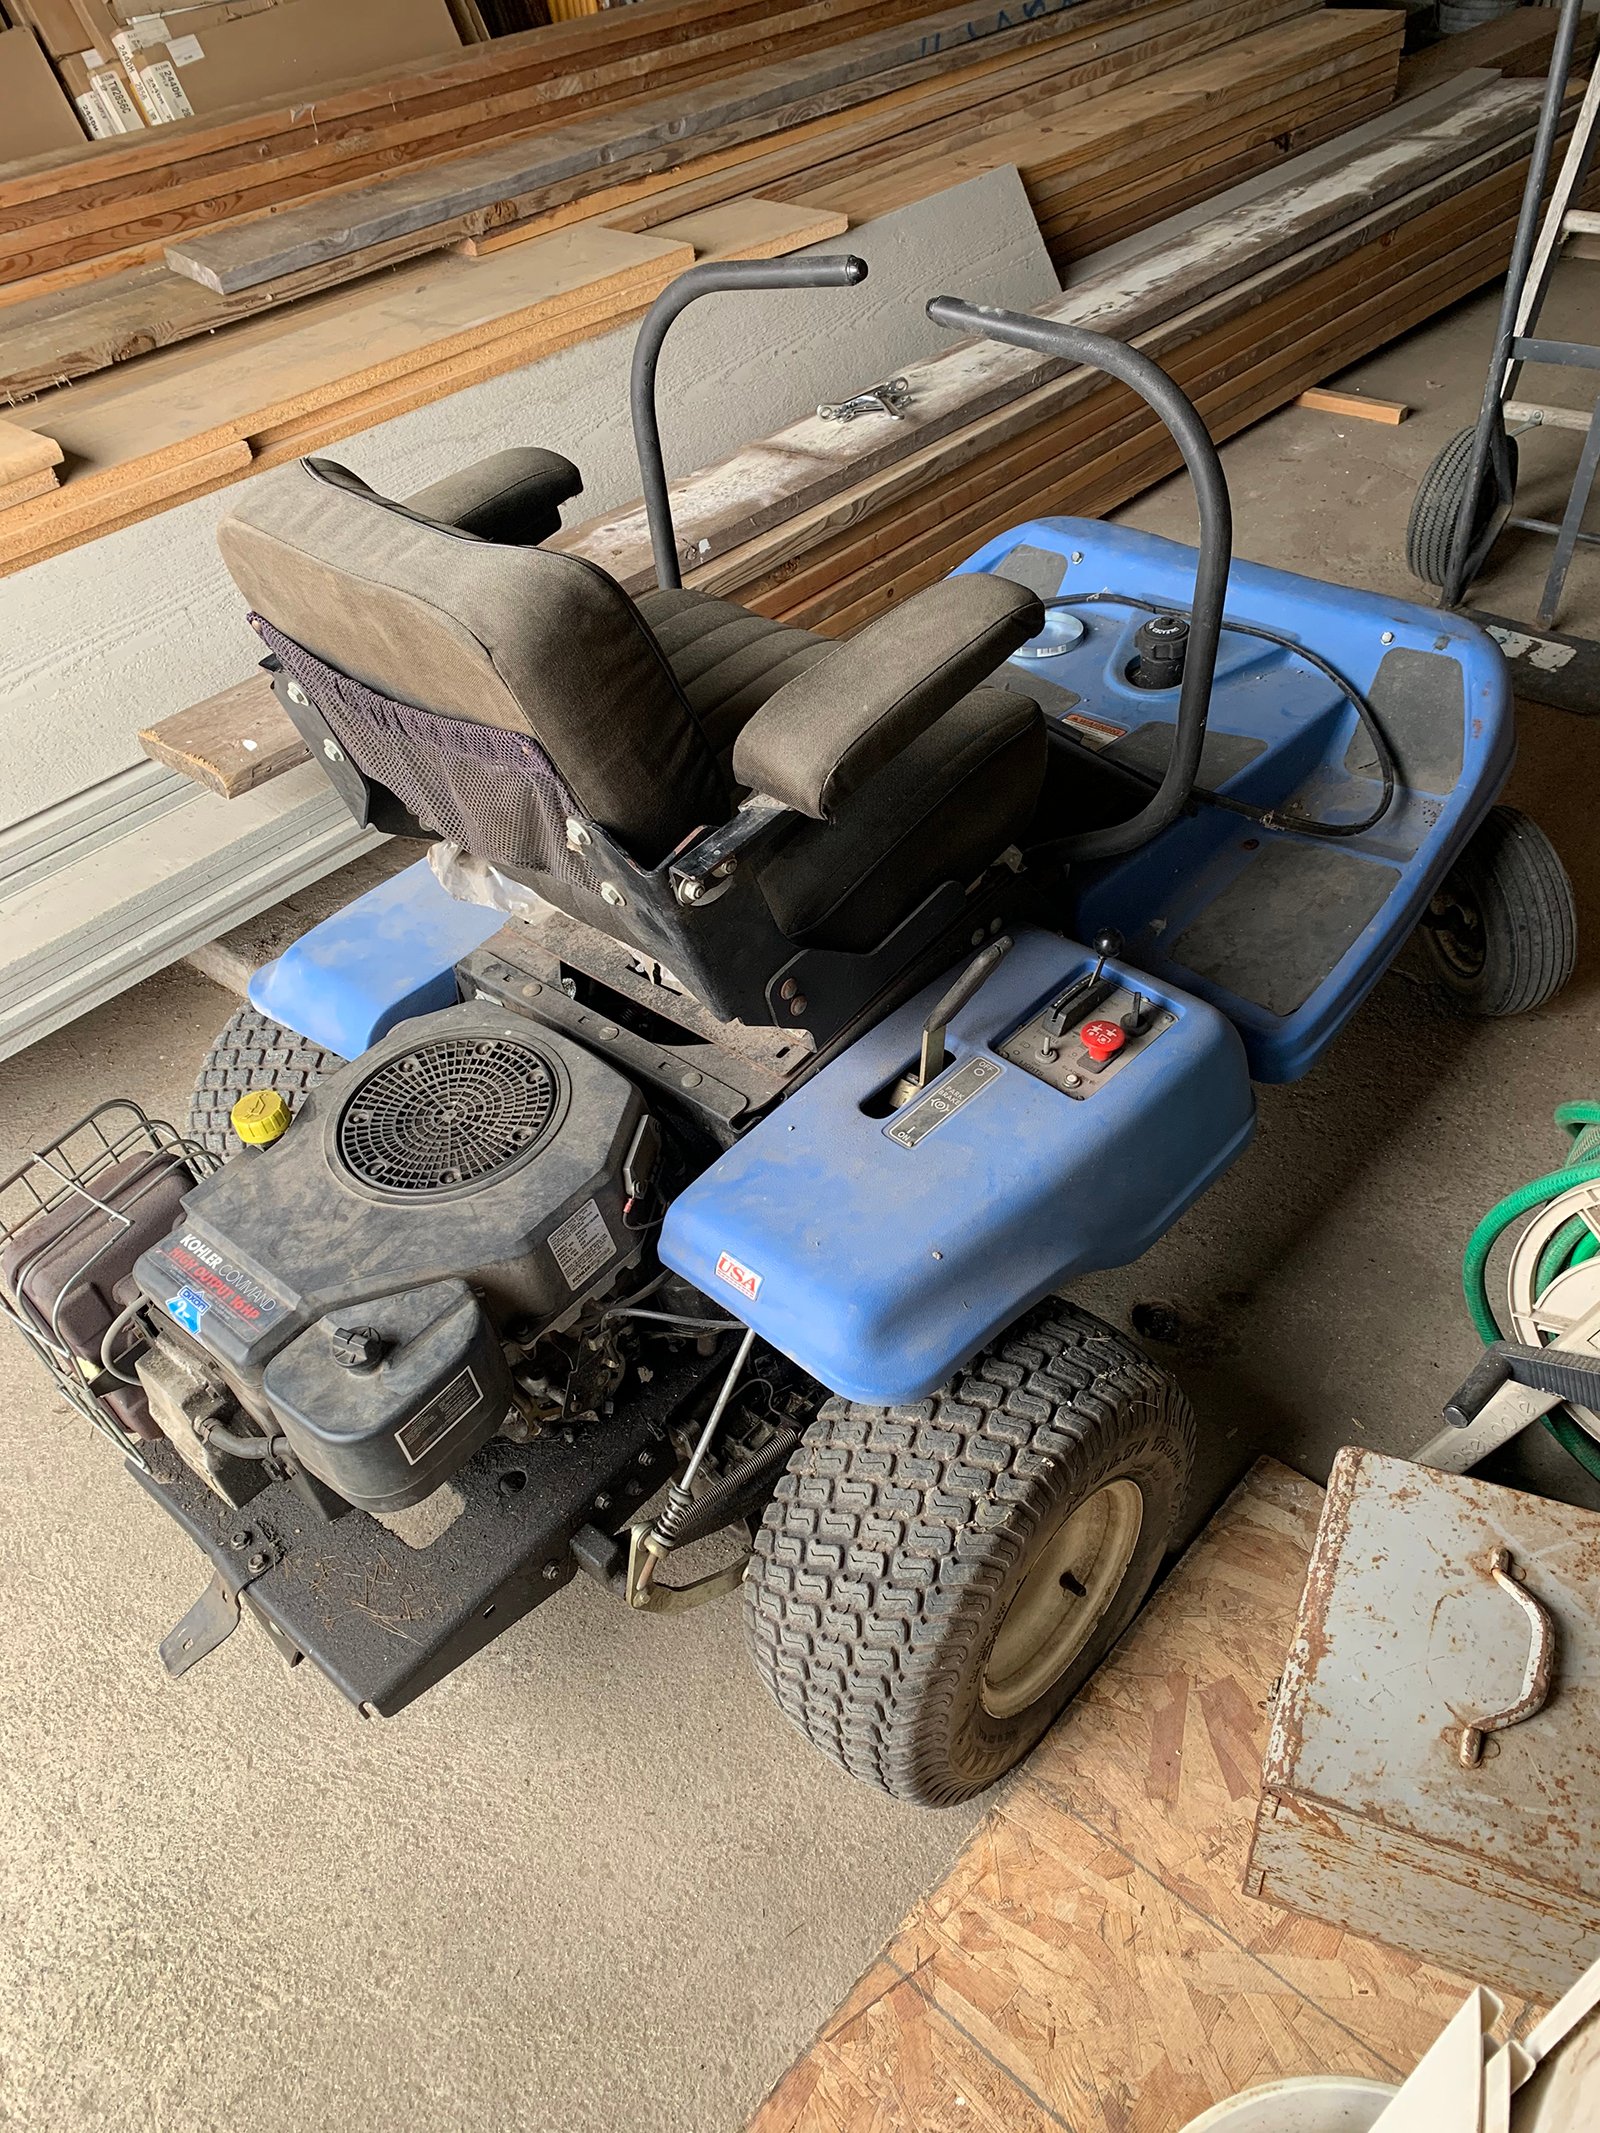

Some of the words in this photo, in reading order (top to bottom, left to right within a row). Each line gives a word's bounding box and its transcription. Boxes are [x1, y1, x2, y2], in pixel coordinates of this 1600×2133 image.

[978, 1061, 995, 1072] OFF
[1018, 1060, 1045, 1077] LIGHTS
[938, 1089, 962, 1105] BRAKE
[944, 1085, 966, 1100] PARK
[897, 1131, 911, 1142] ON
[168, 1247, 199, 1275] HIGH
[193, 1265, 236, 1301] OUTPUT
[180, 1233, 224, 1269] KOHLER
[218, 1264, 277, 1312] COMMAND
[718, 1256, 756, 1292] USA
[182, 1289, 208, 1311] DIXON
